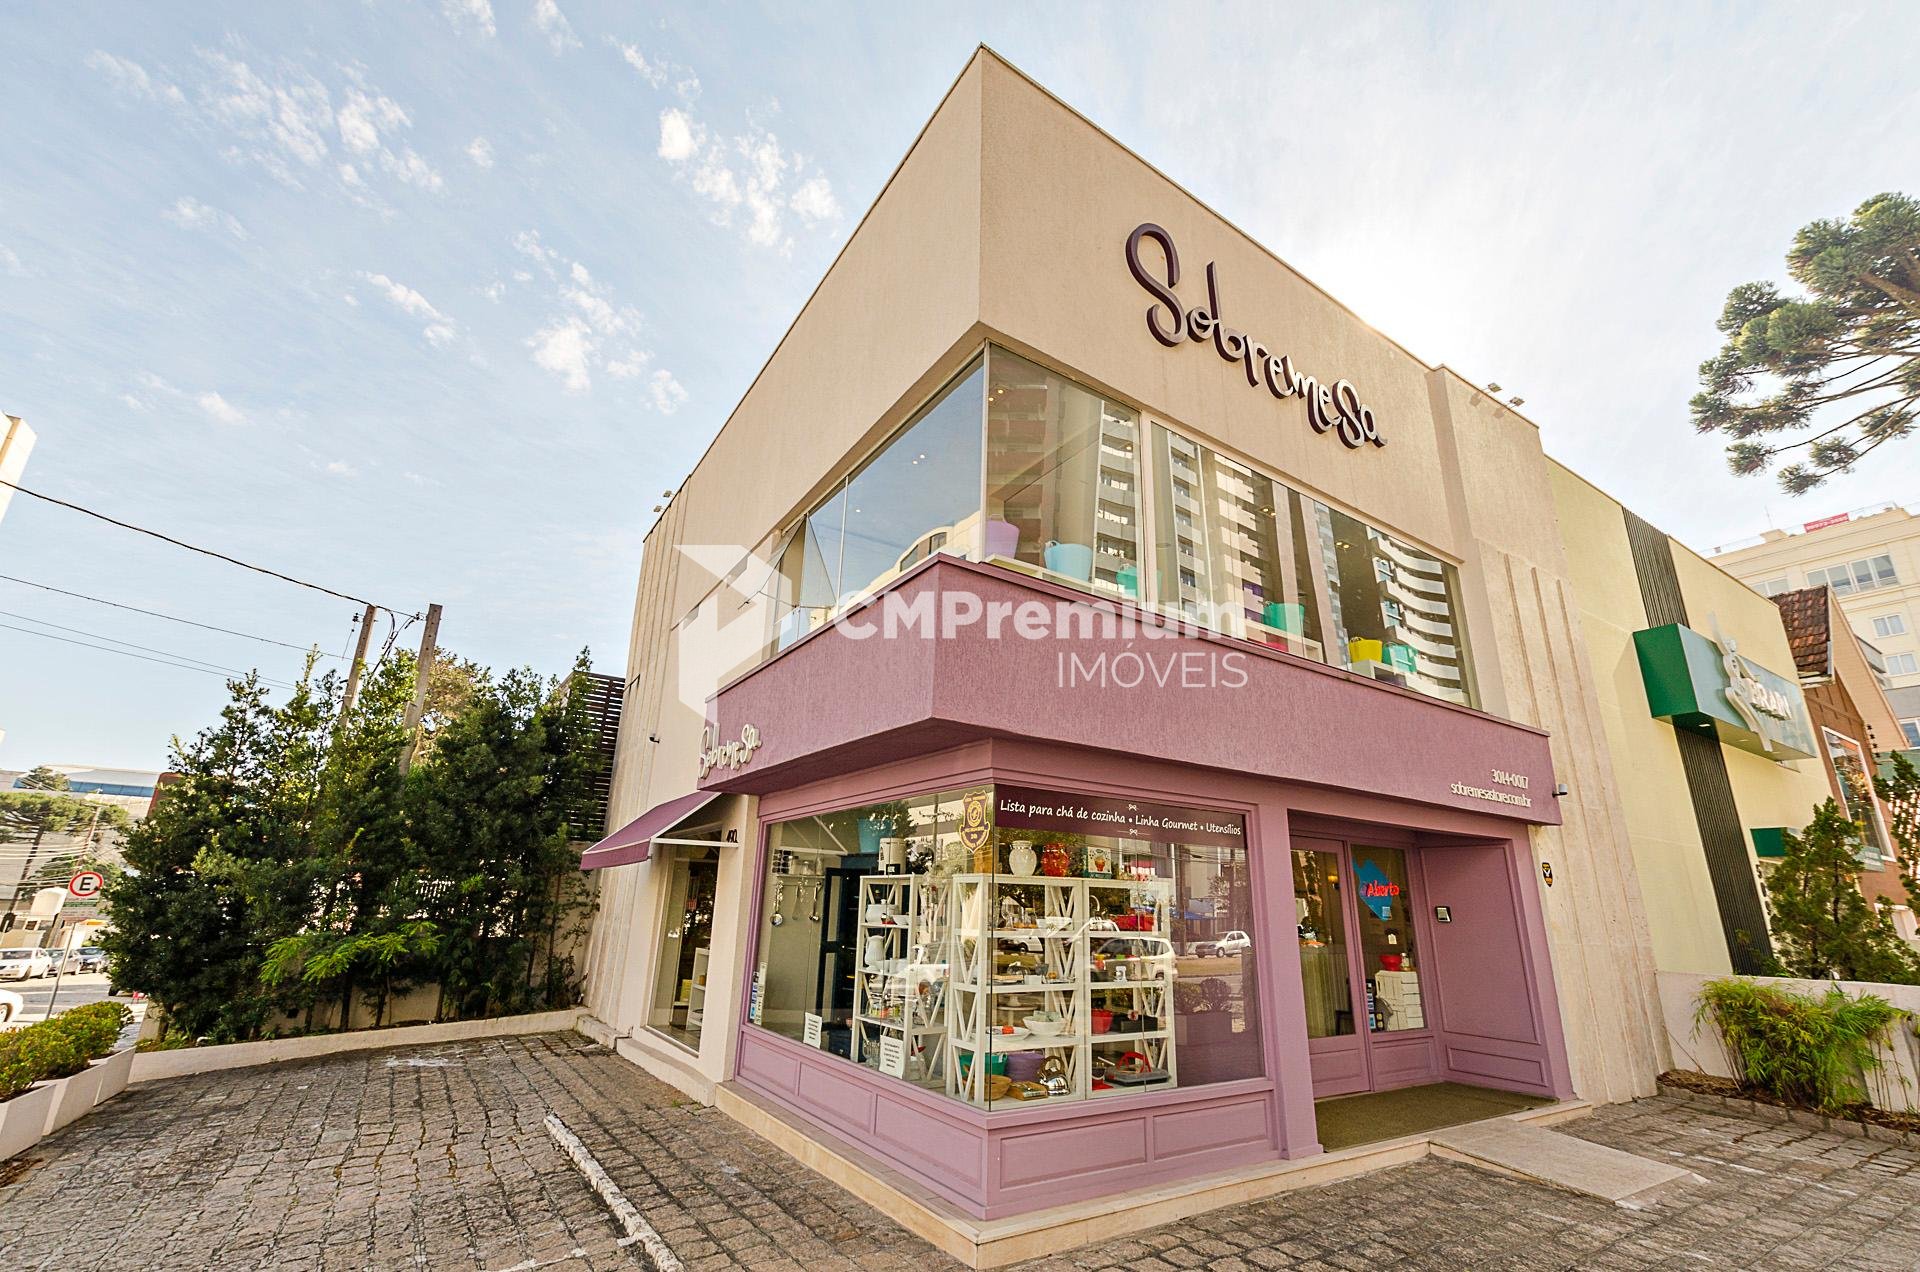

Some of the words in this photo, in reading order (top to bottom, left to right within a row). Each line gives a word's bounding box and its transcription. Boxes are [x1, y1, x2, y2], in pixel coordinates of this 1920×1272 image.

[1000, 799, 1026, 813] Lista
[1029, 805, 1053, 818] para
[1056, 804, 1074, 818] chá
[1077, 806, 1089, 820] de
[1091, 810, 1126, 824] cozinha
[1135, 814, 1160, 828] Linha
[1162, 818, 1198, 831] Gourmet
[1206, 823, 1241, 836] Utensílios
[79, 876, 94, 891] E
